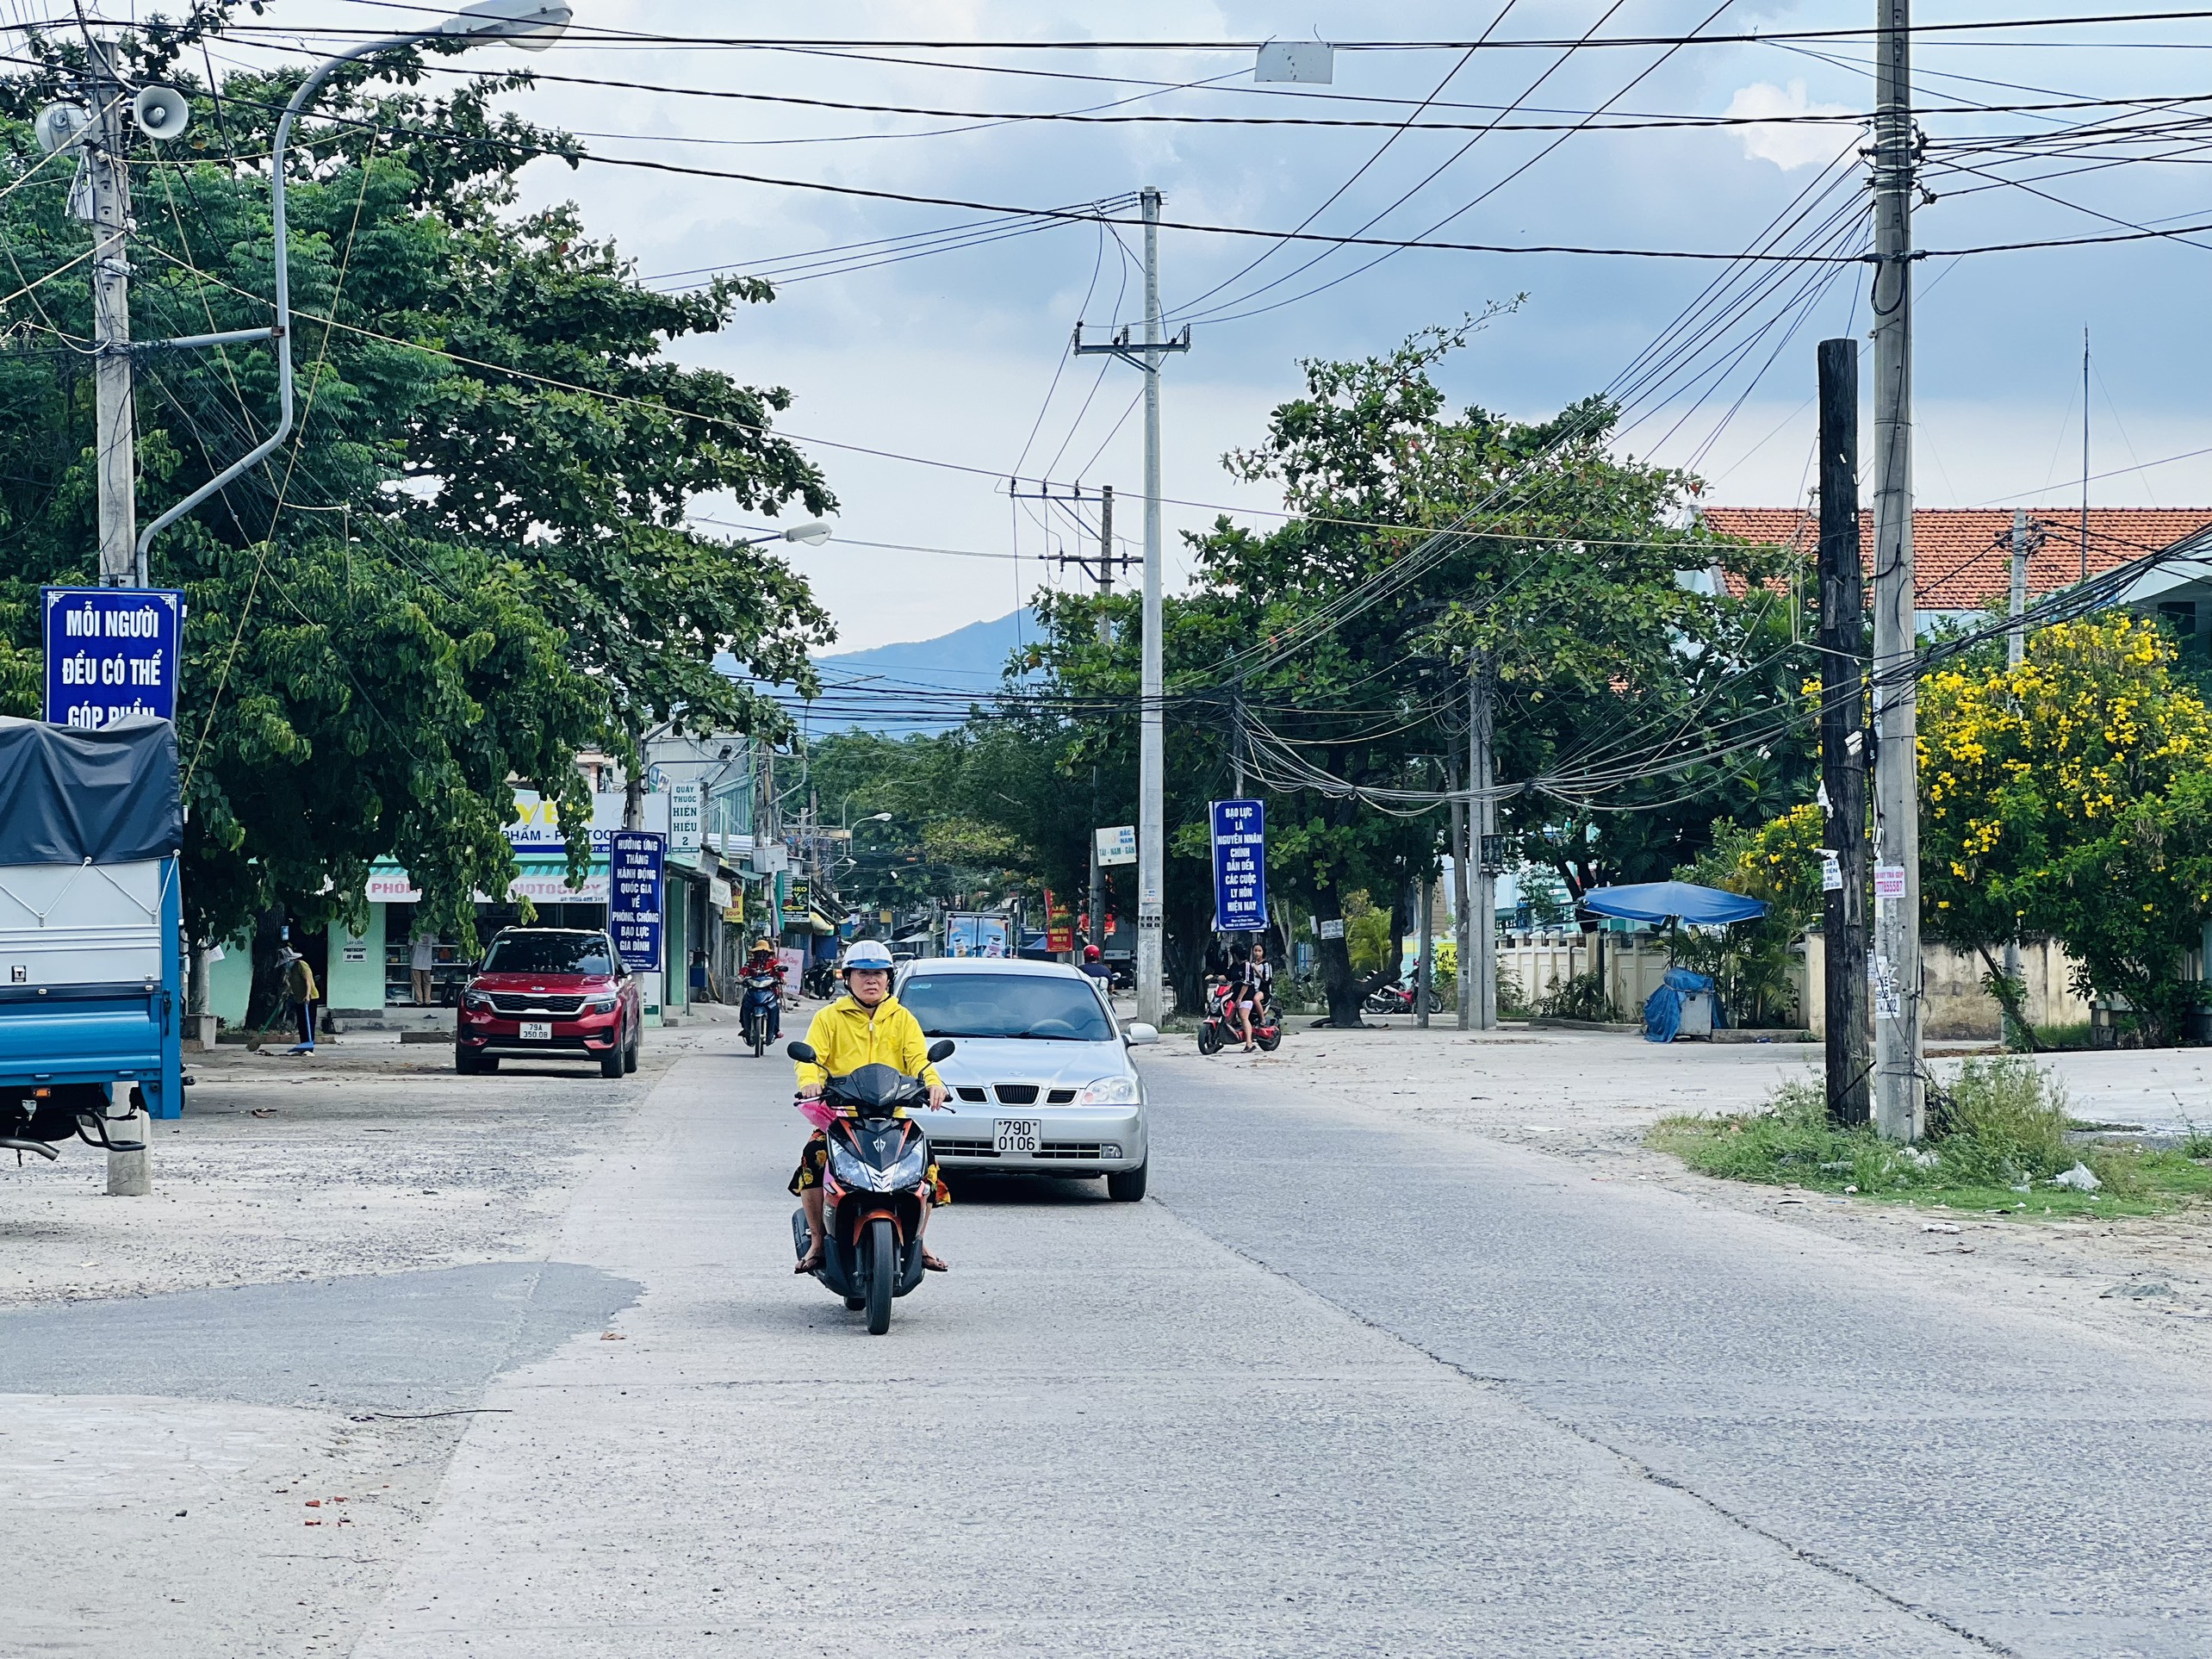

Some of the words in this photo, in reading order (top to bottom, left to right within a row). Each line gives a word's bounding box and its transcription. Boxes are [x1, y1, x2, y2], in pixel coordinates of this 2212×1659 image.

[66, 600, 100, 637] MỖI
[105, 605, 158, 637] NGƯỜI
[62, 649, 96, 685] ĐỀU
[103, 654, 125, 685] CÓ
[130, 649, 162, 686] THỂ
[68, 701, 103, 730] GÓP
[1225, 807, 1239, 819] BẠO
[1240, 806, 1252, 818] LỰC
[1235, 818, 1244, 830] LÀ
[682, 836, 688, 846] 2
[626, 852, 649, 865] THÁNG
[1225, 873, 1239, 885] CÁC
[640, 884, 652, 894] GIA
[1230, 888, 1238, 898] LY
[1244, 900, 1257, 910] NAY
[620, 941, 631, 951] GIA
[1003, 1121, 1030, 1135] 79D
[998, 1136, 1035, 1150] 0106
